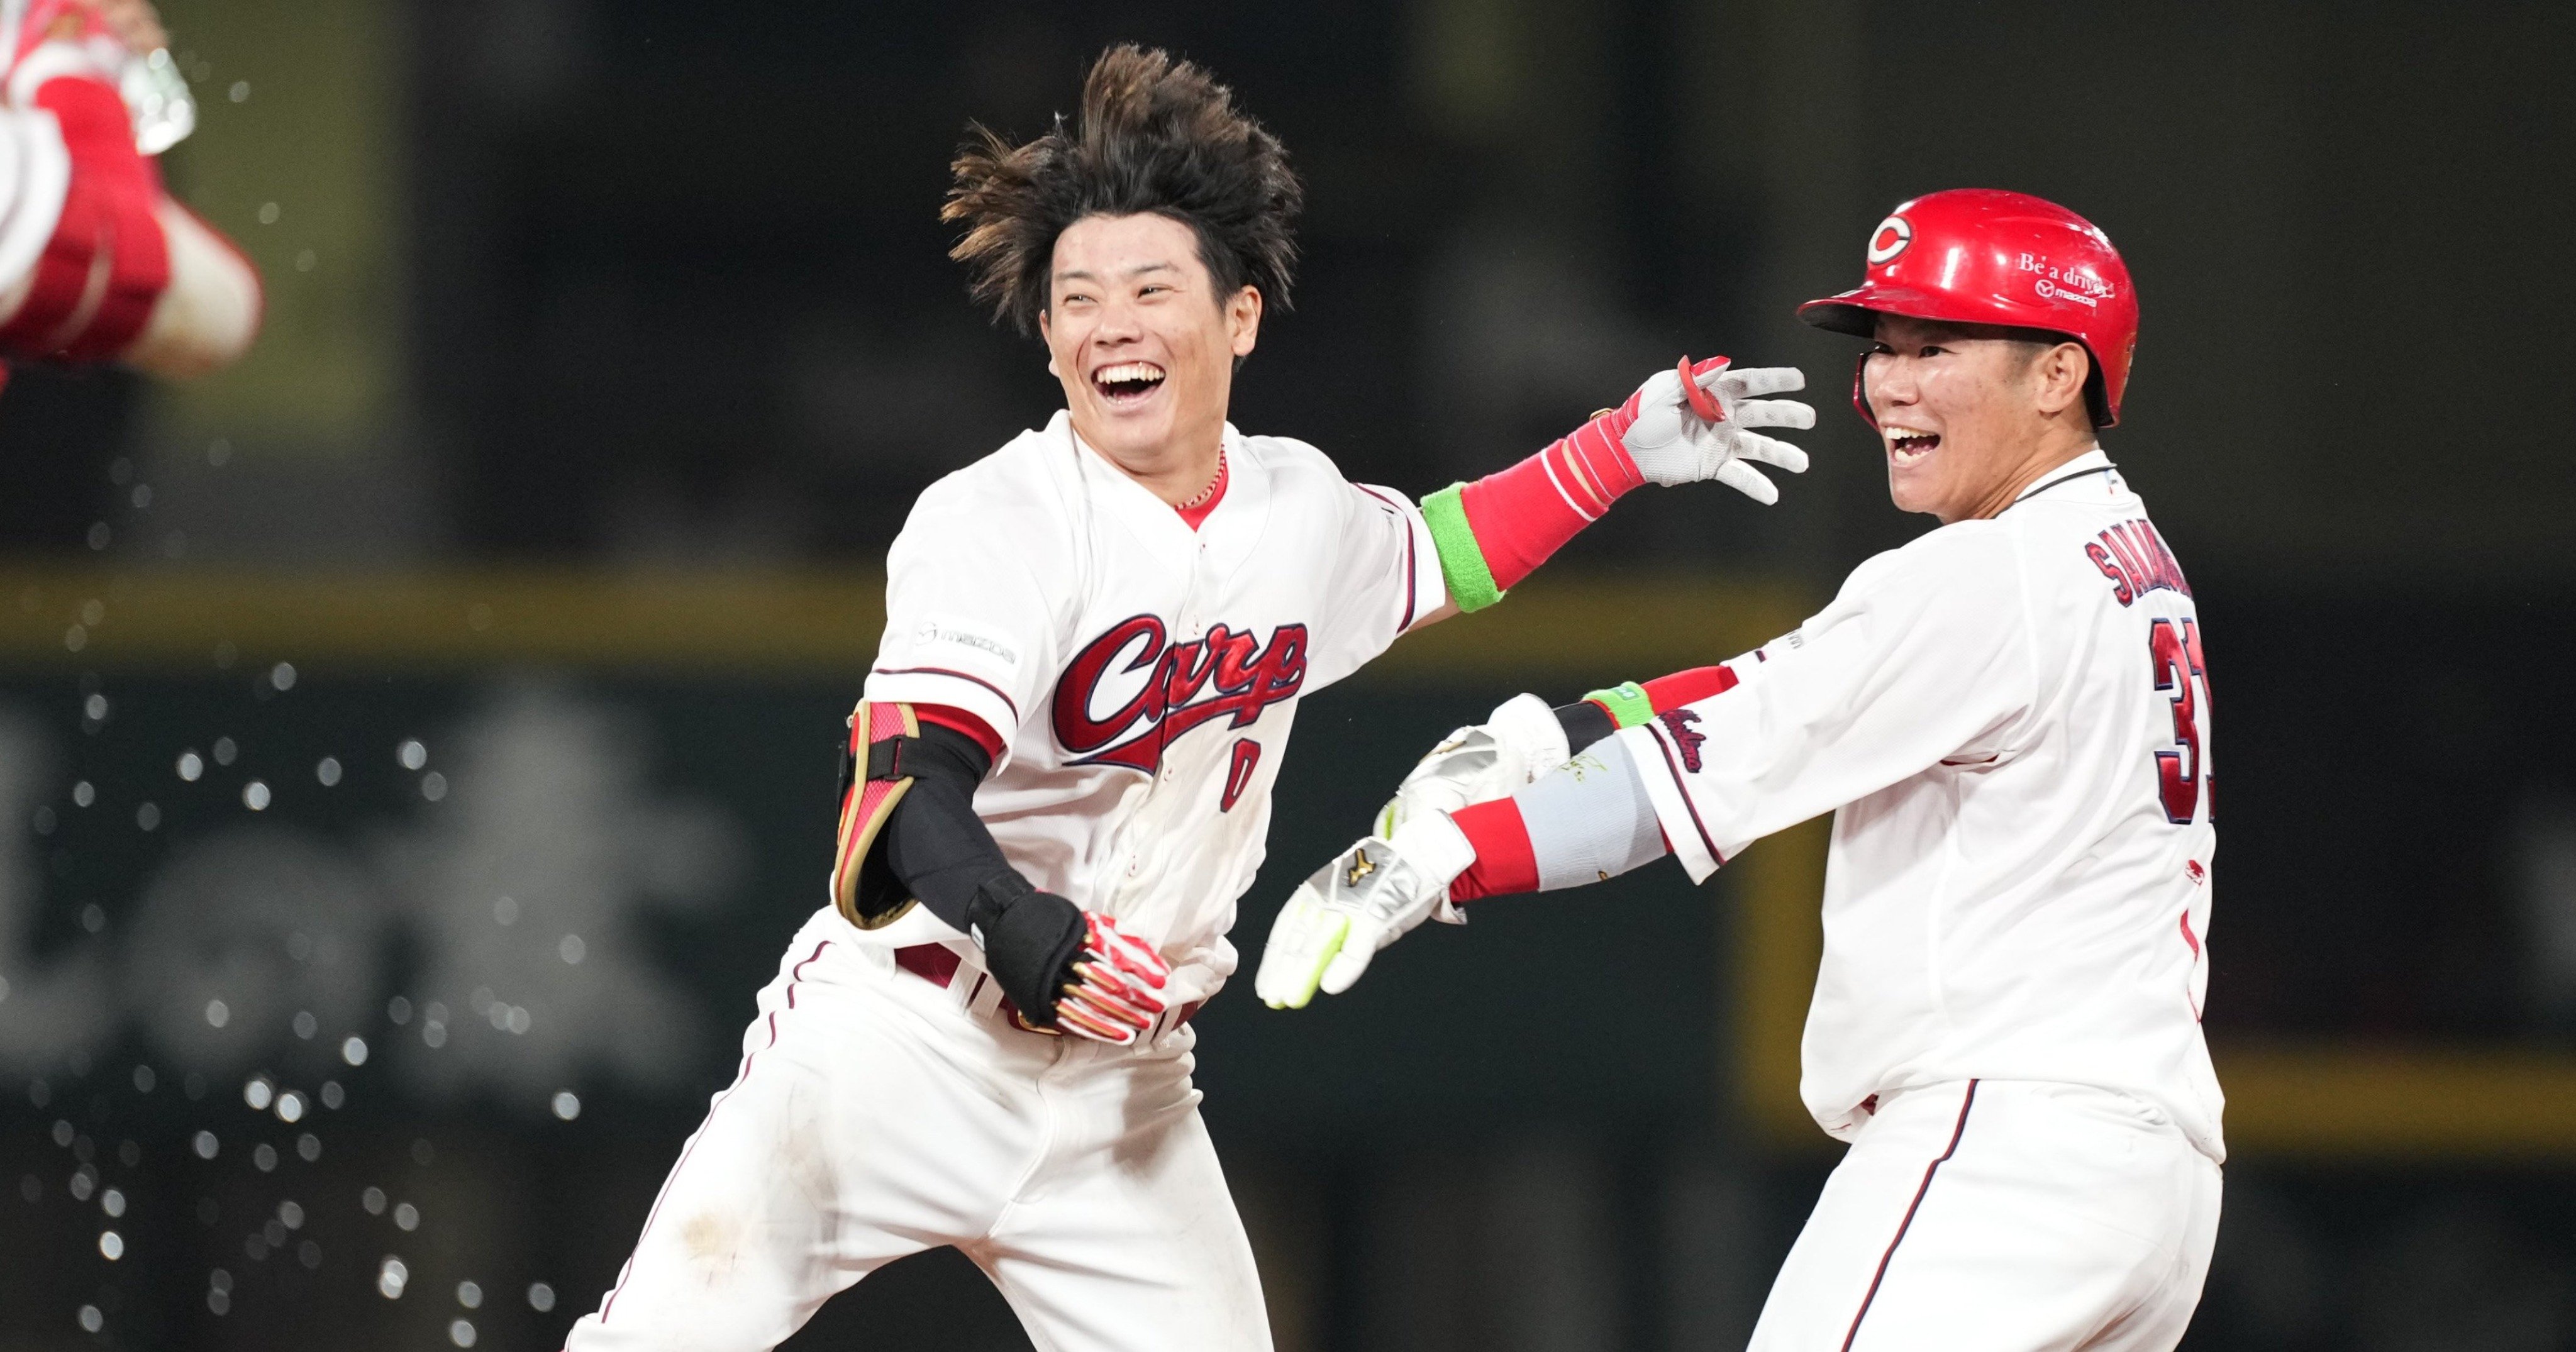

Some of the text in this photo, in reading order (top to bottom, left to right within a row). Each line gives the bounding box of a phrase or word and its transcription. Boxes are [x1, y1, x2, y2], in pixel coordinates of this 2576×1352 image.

[1868, 216, 1911, 265] C
[2048, 266, 2059, 280] a
[1052, 613, 1309, 777] Carp
[1220, 738, 1262, 813] 0
